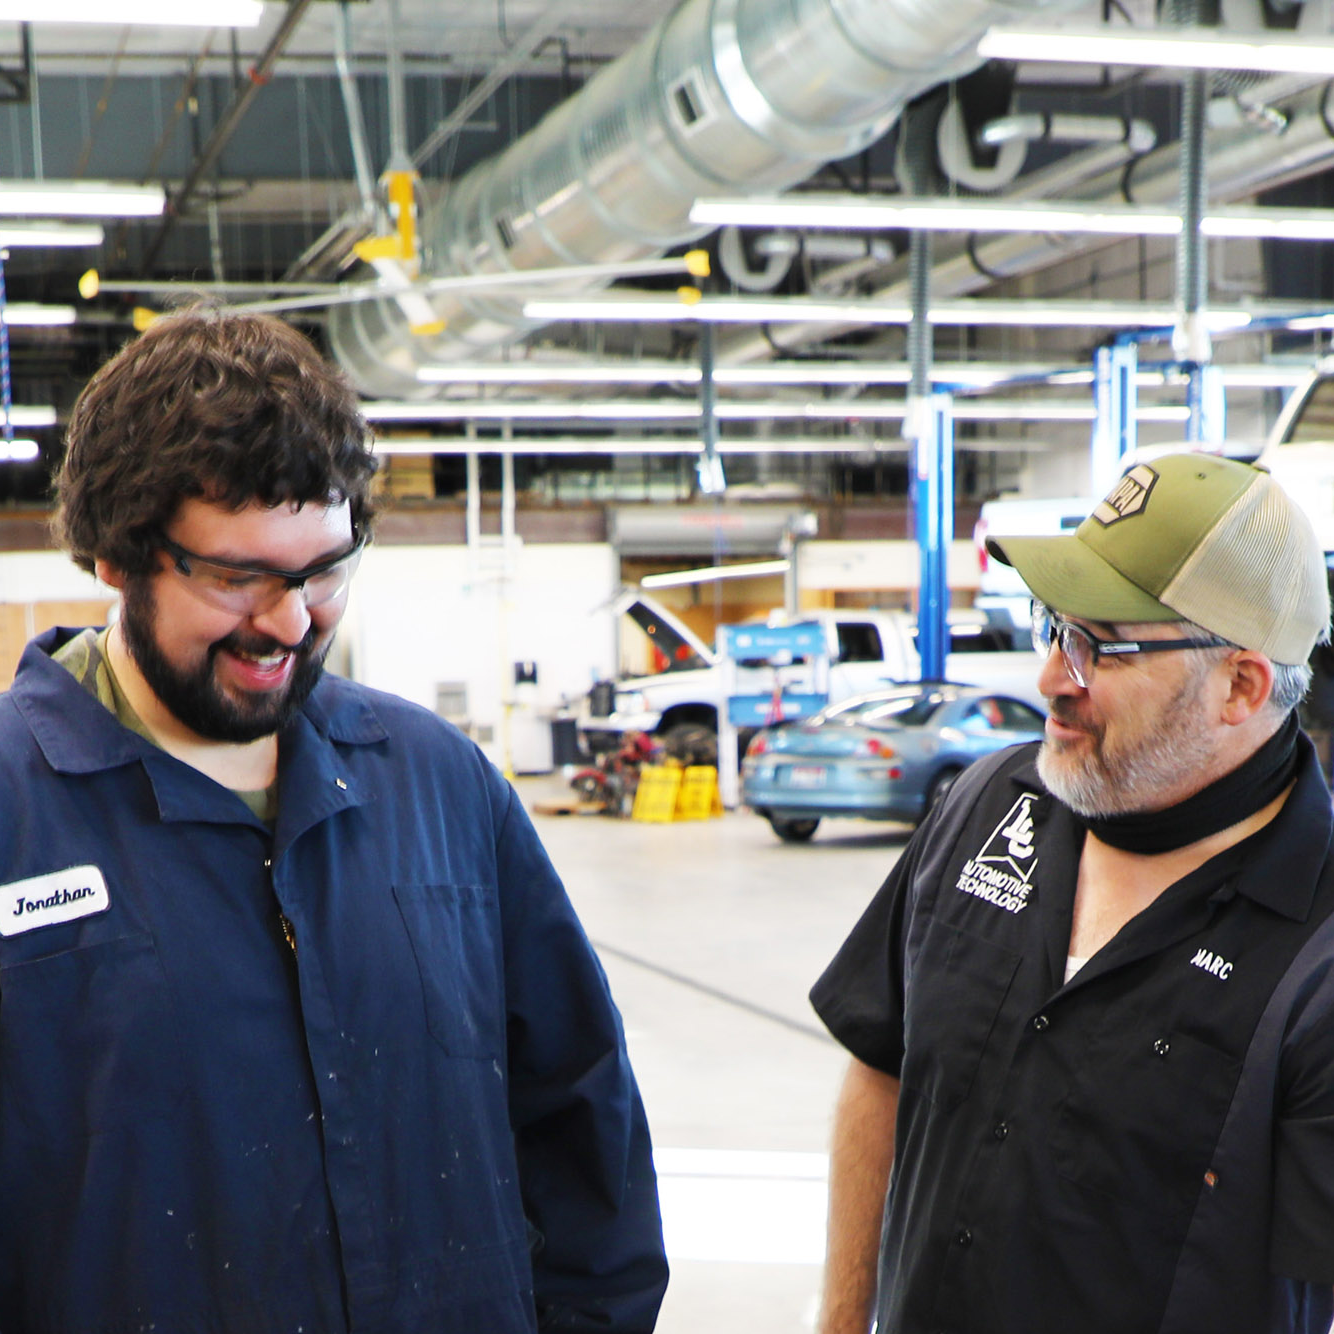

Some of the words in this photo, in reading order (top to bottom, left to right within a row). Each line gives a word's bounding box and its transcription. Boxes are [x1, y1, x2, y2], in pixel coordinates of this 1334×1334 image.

[955, 873, 1028, 914] TECHNOLOGY
[961, 859, 1034, 899] AUTOMOTIVE
[12, 886, 96, 916] Jonathan
[1190, 948, 1234, 980] MARC
